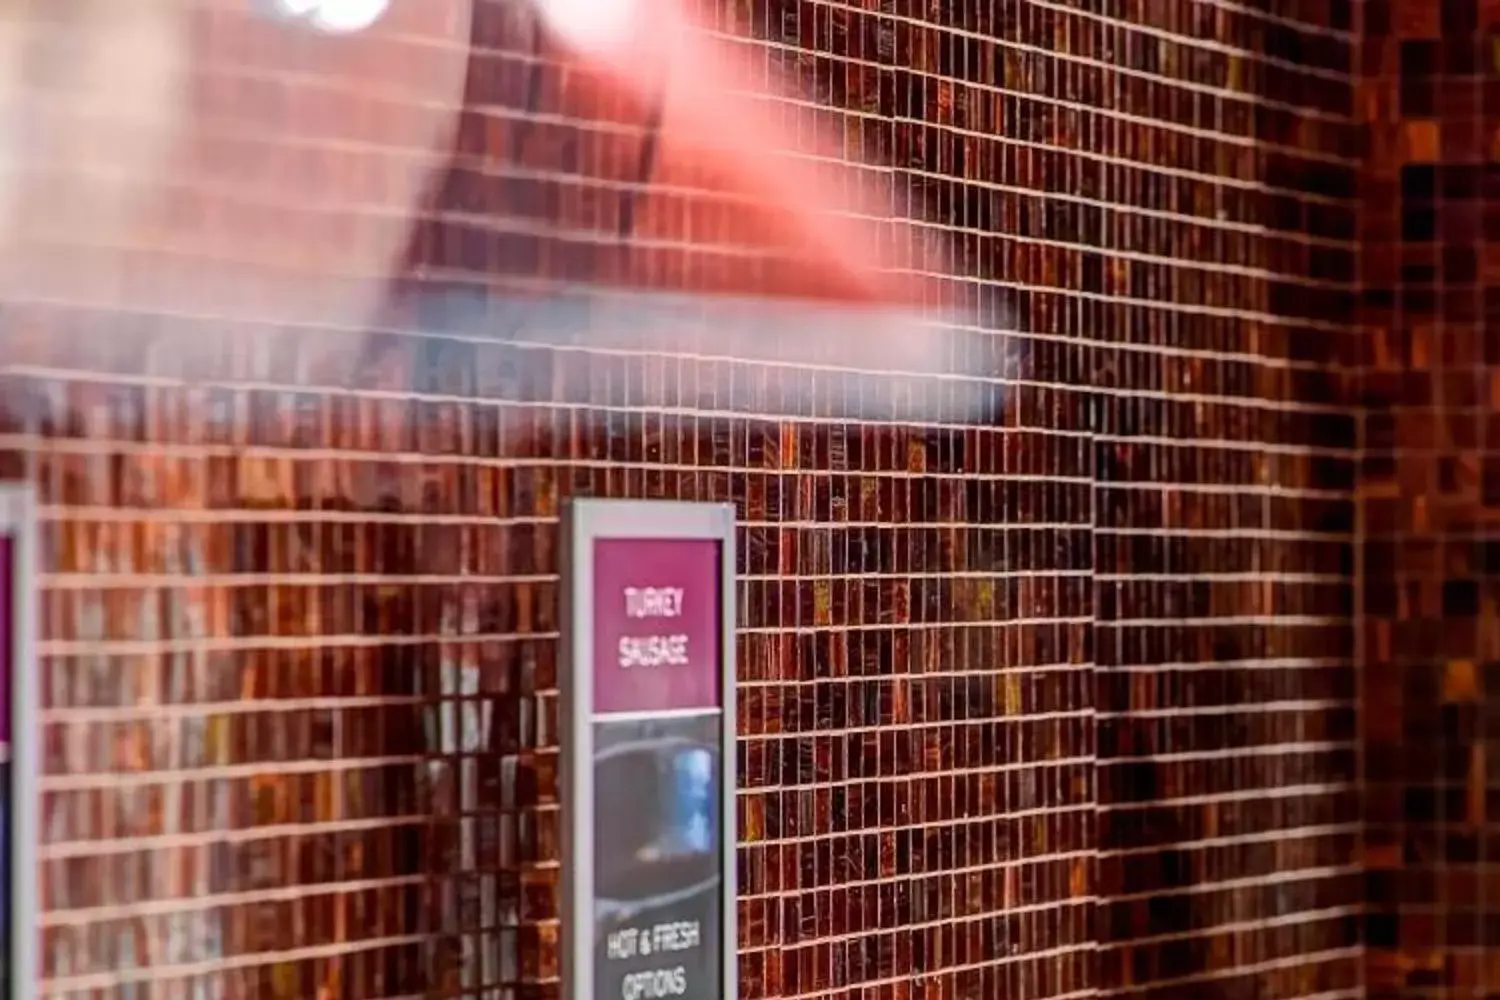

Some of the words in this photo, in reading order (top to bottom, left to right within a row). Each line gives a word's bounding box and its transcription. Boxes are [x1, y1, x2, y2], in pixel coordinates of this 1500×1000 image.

[624, 586, 684, 619] TURKEY
[618, 634, 689, 667] SAUSAGE
[607, 927, 639, 959] HOT
[653, 919, 701, 952] FRESH
